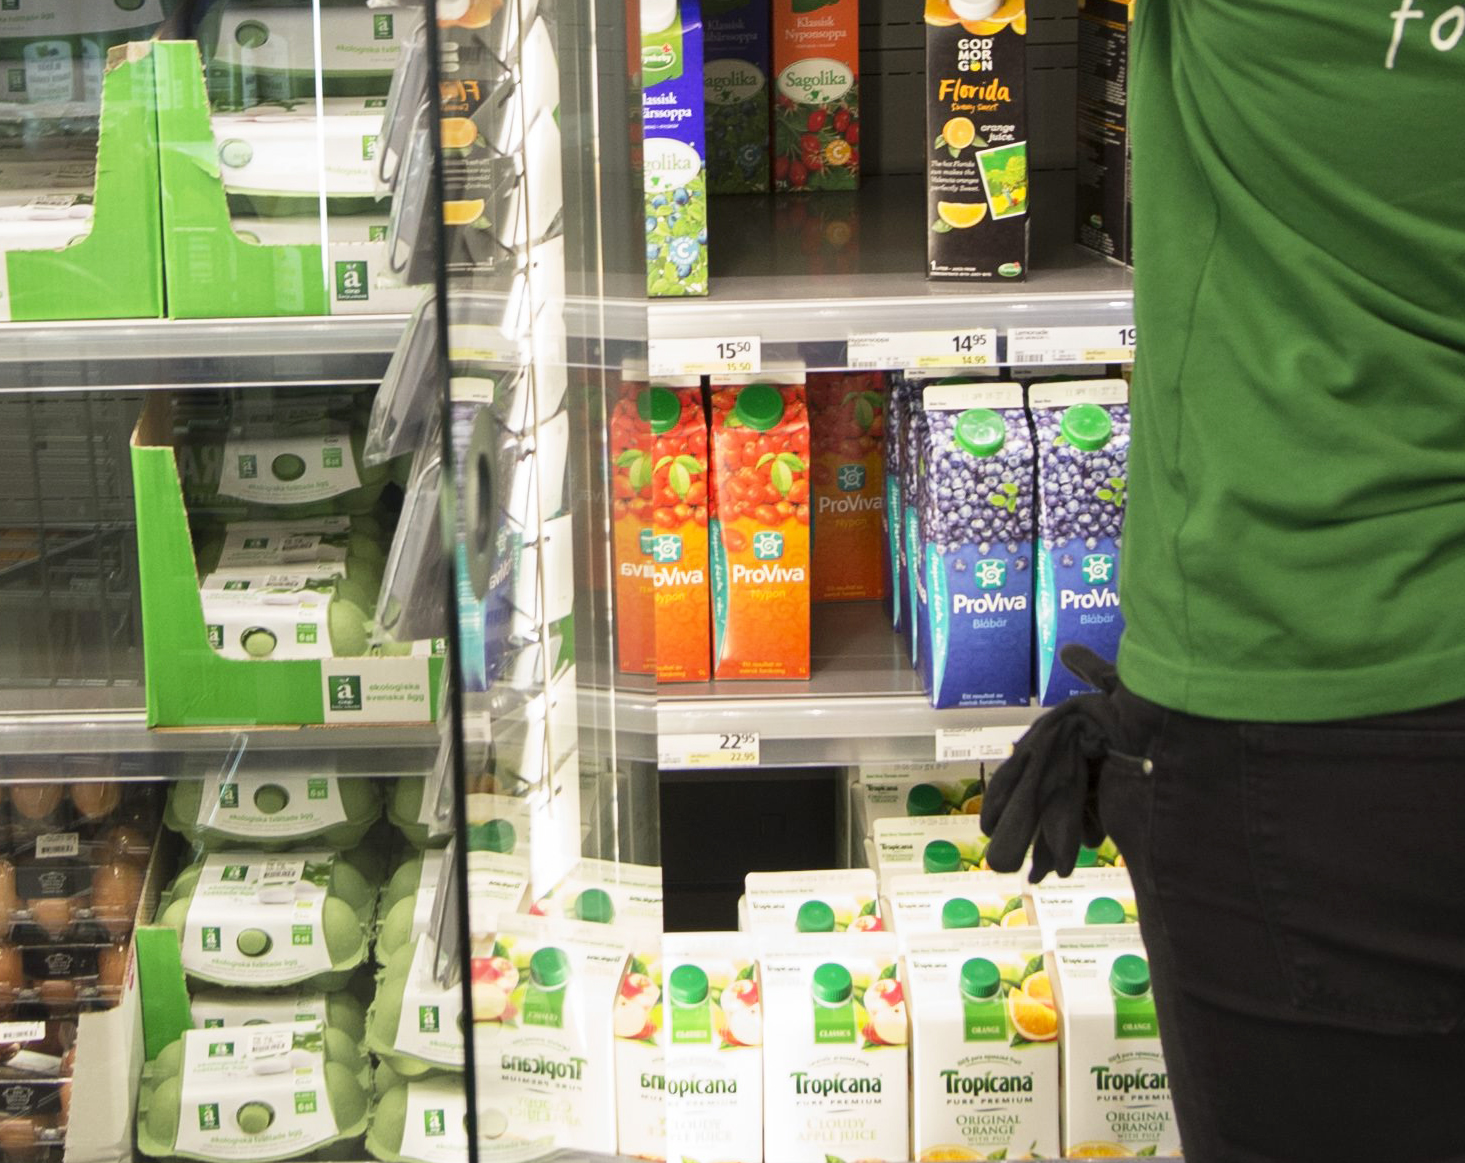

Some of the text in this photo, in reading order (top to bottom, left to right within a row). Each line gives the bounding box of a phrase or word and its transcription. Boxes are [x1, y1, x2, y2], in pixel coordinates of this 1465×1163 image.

[796, 17, 835, 28] Klassisk
[785, 28, 848, 42] Nyponsoppa
[957, 39, 992, 50] GOD
[957, 49, 993, 61] MOR
[786, 68, 848, 90] Sagolika
[938, 77, 1012, 103] Florida
[818, 494, 884, 514] ProViva
[732, 564, 805, 584] ProViva
[953, 593, 1028, 615] ProViva
[973, 616, 1009, 630] Blåbär
[971, 1025, 1000, 1035] ORANGE
[1122, 1022, 1152, 1032] ORANGE
[790, 1069, 883, 1096] Tropicana
[939, 1068, 1034, 1096] Tropicana
[956, 1113, 1022, 1127] ORIGINAL
[1105, 1111, 1171, 1124] ORIGINAL
[961, 1124, 1016, 1136] ORANGE
[1110, 1121, 1165, 1134] ORANGE
